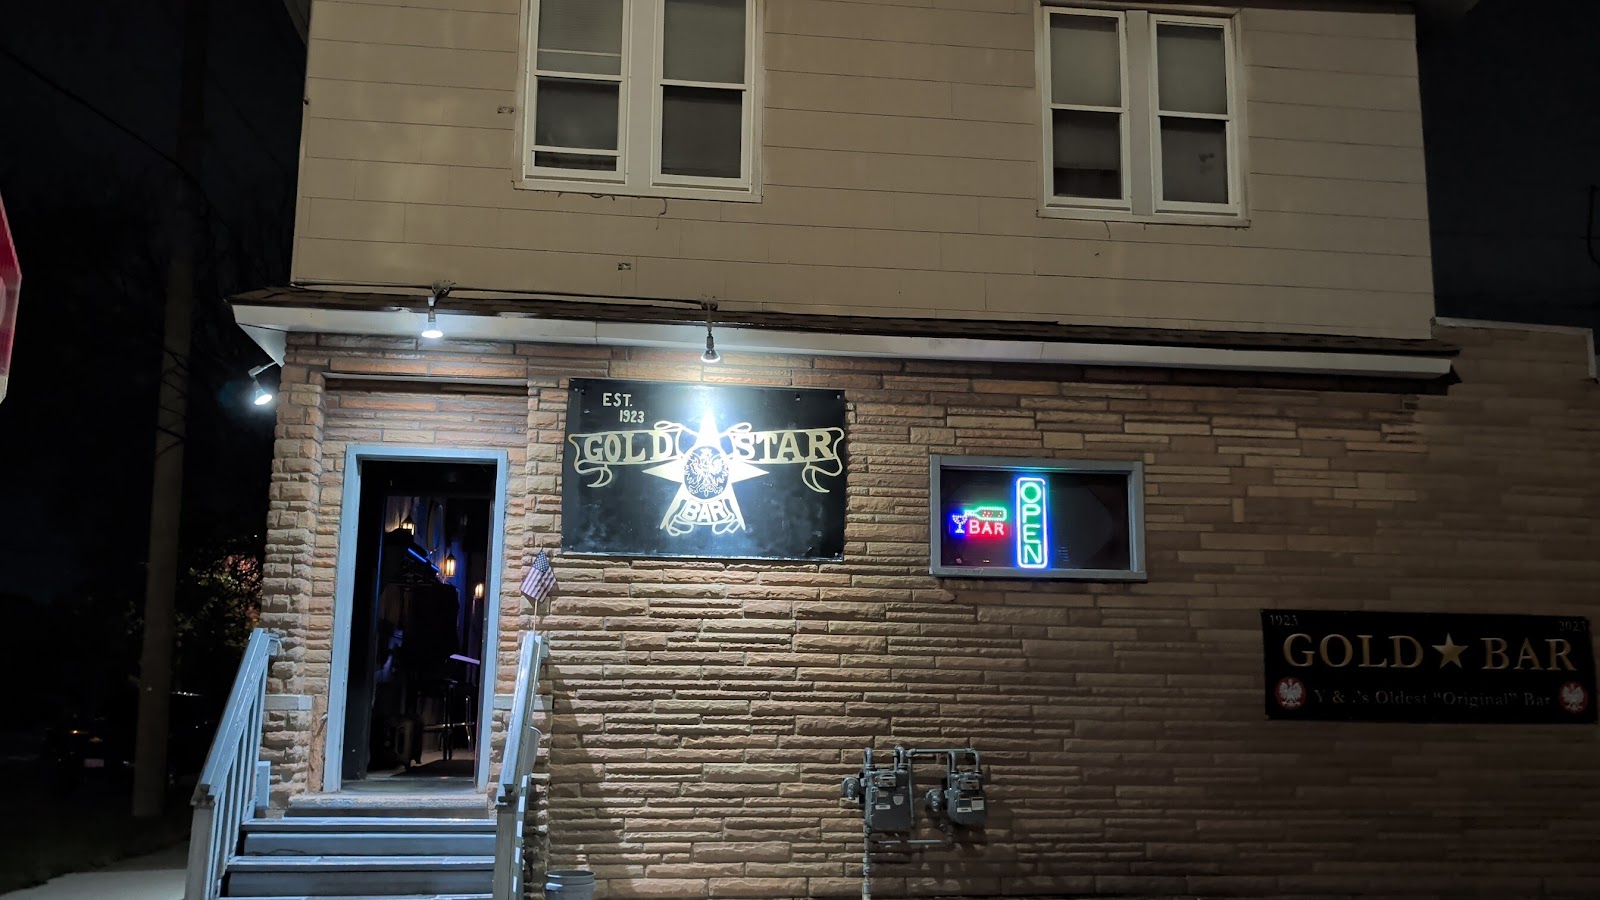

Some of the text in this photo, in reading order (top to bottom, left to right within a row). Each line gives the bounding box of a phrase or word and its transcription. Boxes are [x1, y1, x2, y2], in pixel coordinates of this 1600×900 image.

[602, 392, 633, 407] EST.
[619, 410, 645, 424] 1923
[584, 430, 836, 463] GOLD STAR
[684, 500, 727, 522] BAR
[969, 519, 1005, 536] BAR
[1020, 481, 1043, 565] OPEN
[1269, 614, 1299, 627] 1923
[1282, 632, 1578, 671] GOLD BAR
[1375, 689, 1428, 705] Oldest
[1523, 691, 1551, 707] Bar
